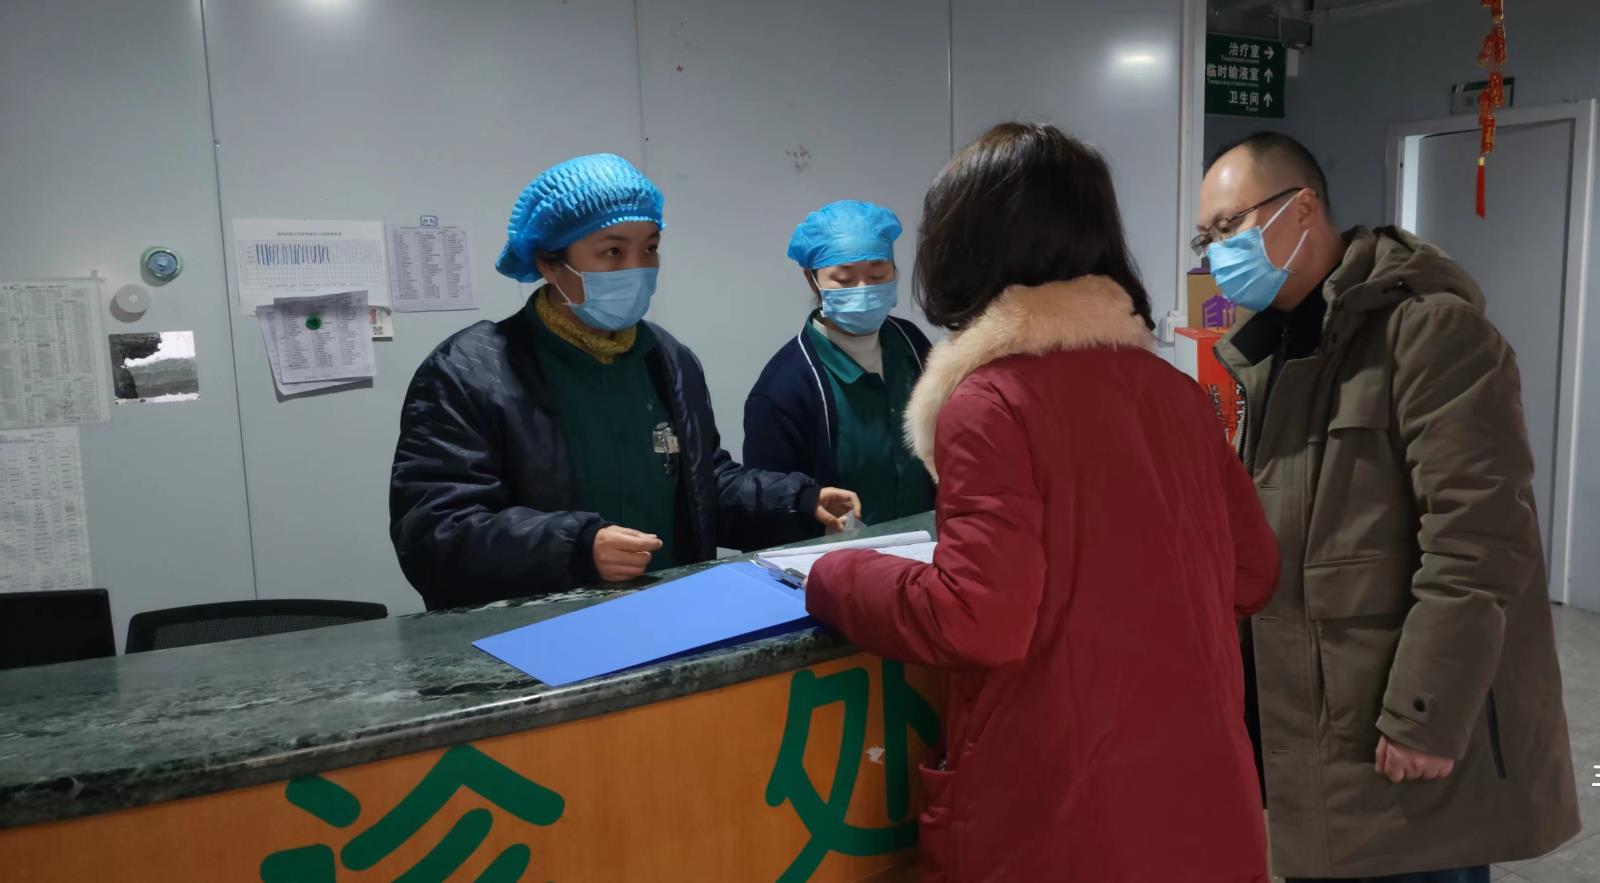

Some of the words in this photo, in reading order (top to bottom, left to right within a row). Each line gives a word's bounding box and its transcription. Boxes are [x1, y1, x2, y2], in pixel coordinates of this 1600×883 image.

[1228, 42, 1260, 58] 治疗室
[1207, 63, 1260, 80] 临时输液室
[1229, 91, 1260, 105] 卫生间
